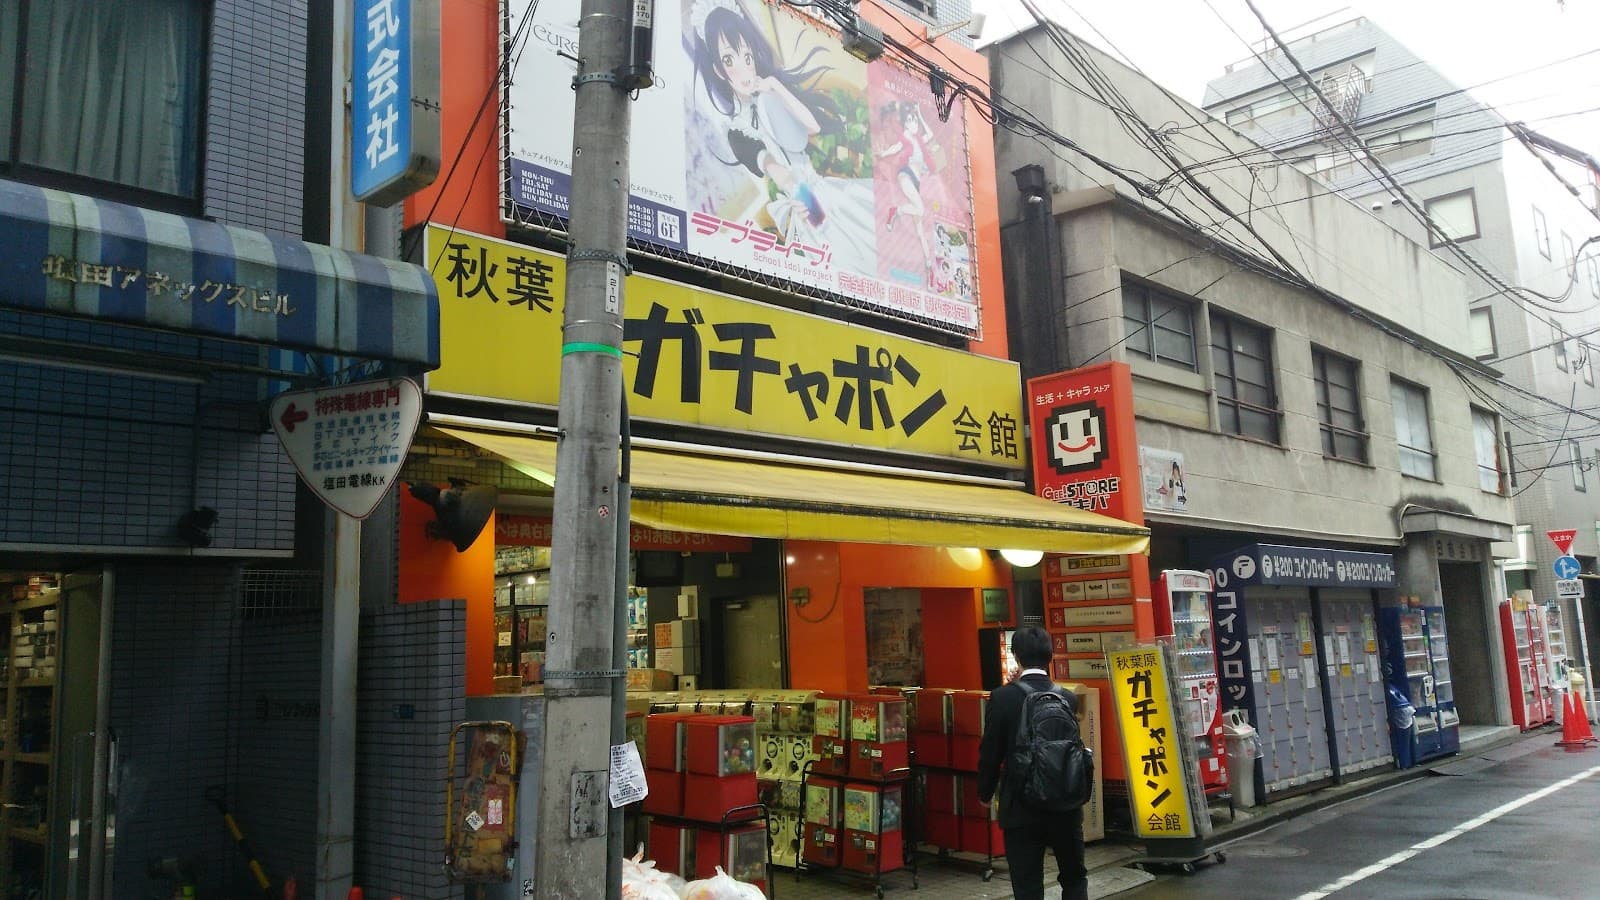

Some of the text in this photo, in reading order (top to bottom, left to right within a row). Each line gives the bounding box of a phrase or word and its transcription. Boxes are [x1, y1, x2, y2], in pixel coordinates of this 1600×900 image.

[660, 221, 678, 238] 6F
[753, 252, 833, 282] School idol project
[446, 243, 1019, 461] 秋葉 ガチャポン 会館
[1036, 392, 1054, 406] 生活
[1066, 386, 1090, 399] キャラ
[1093, 384, 1110, 394] ストア
[1294, 557, 1334, 580] コインロッカー
[1116, 653, 1157, 671] 秋葉原
[1127, 671, 1172, 808] ガチャポン
[1147, 812, 1181, 831] 会館
